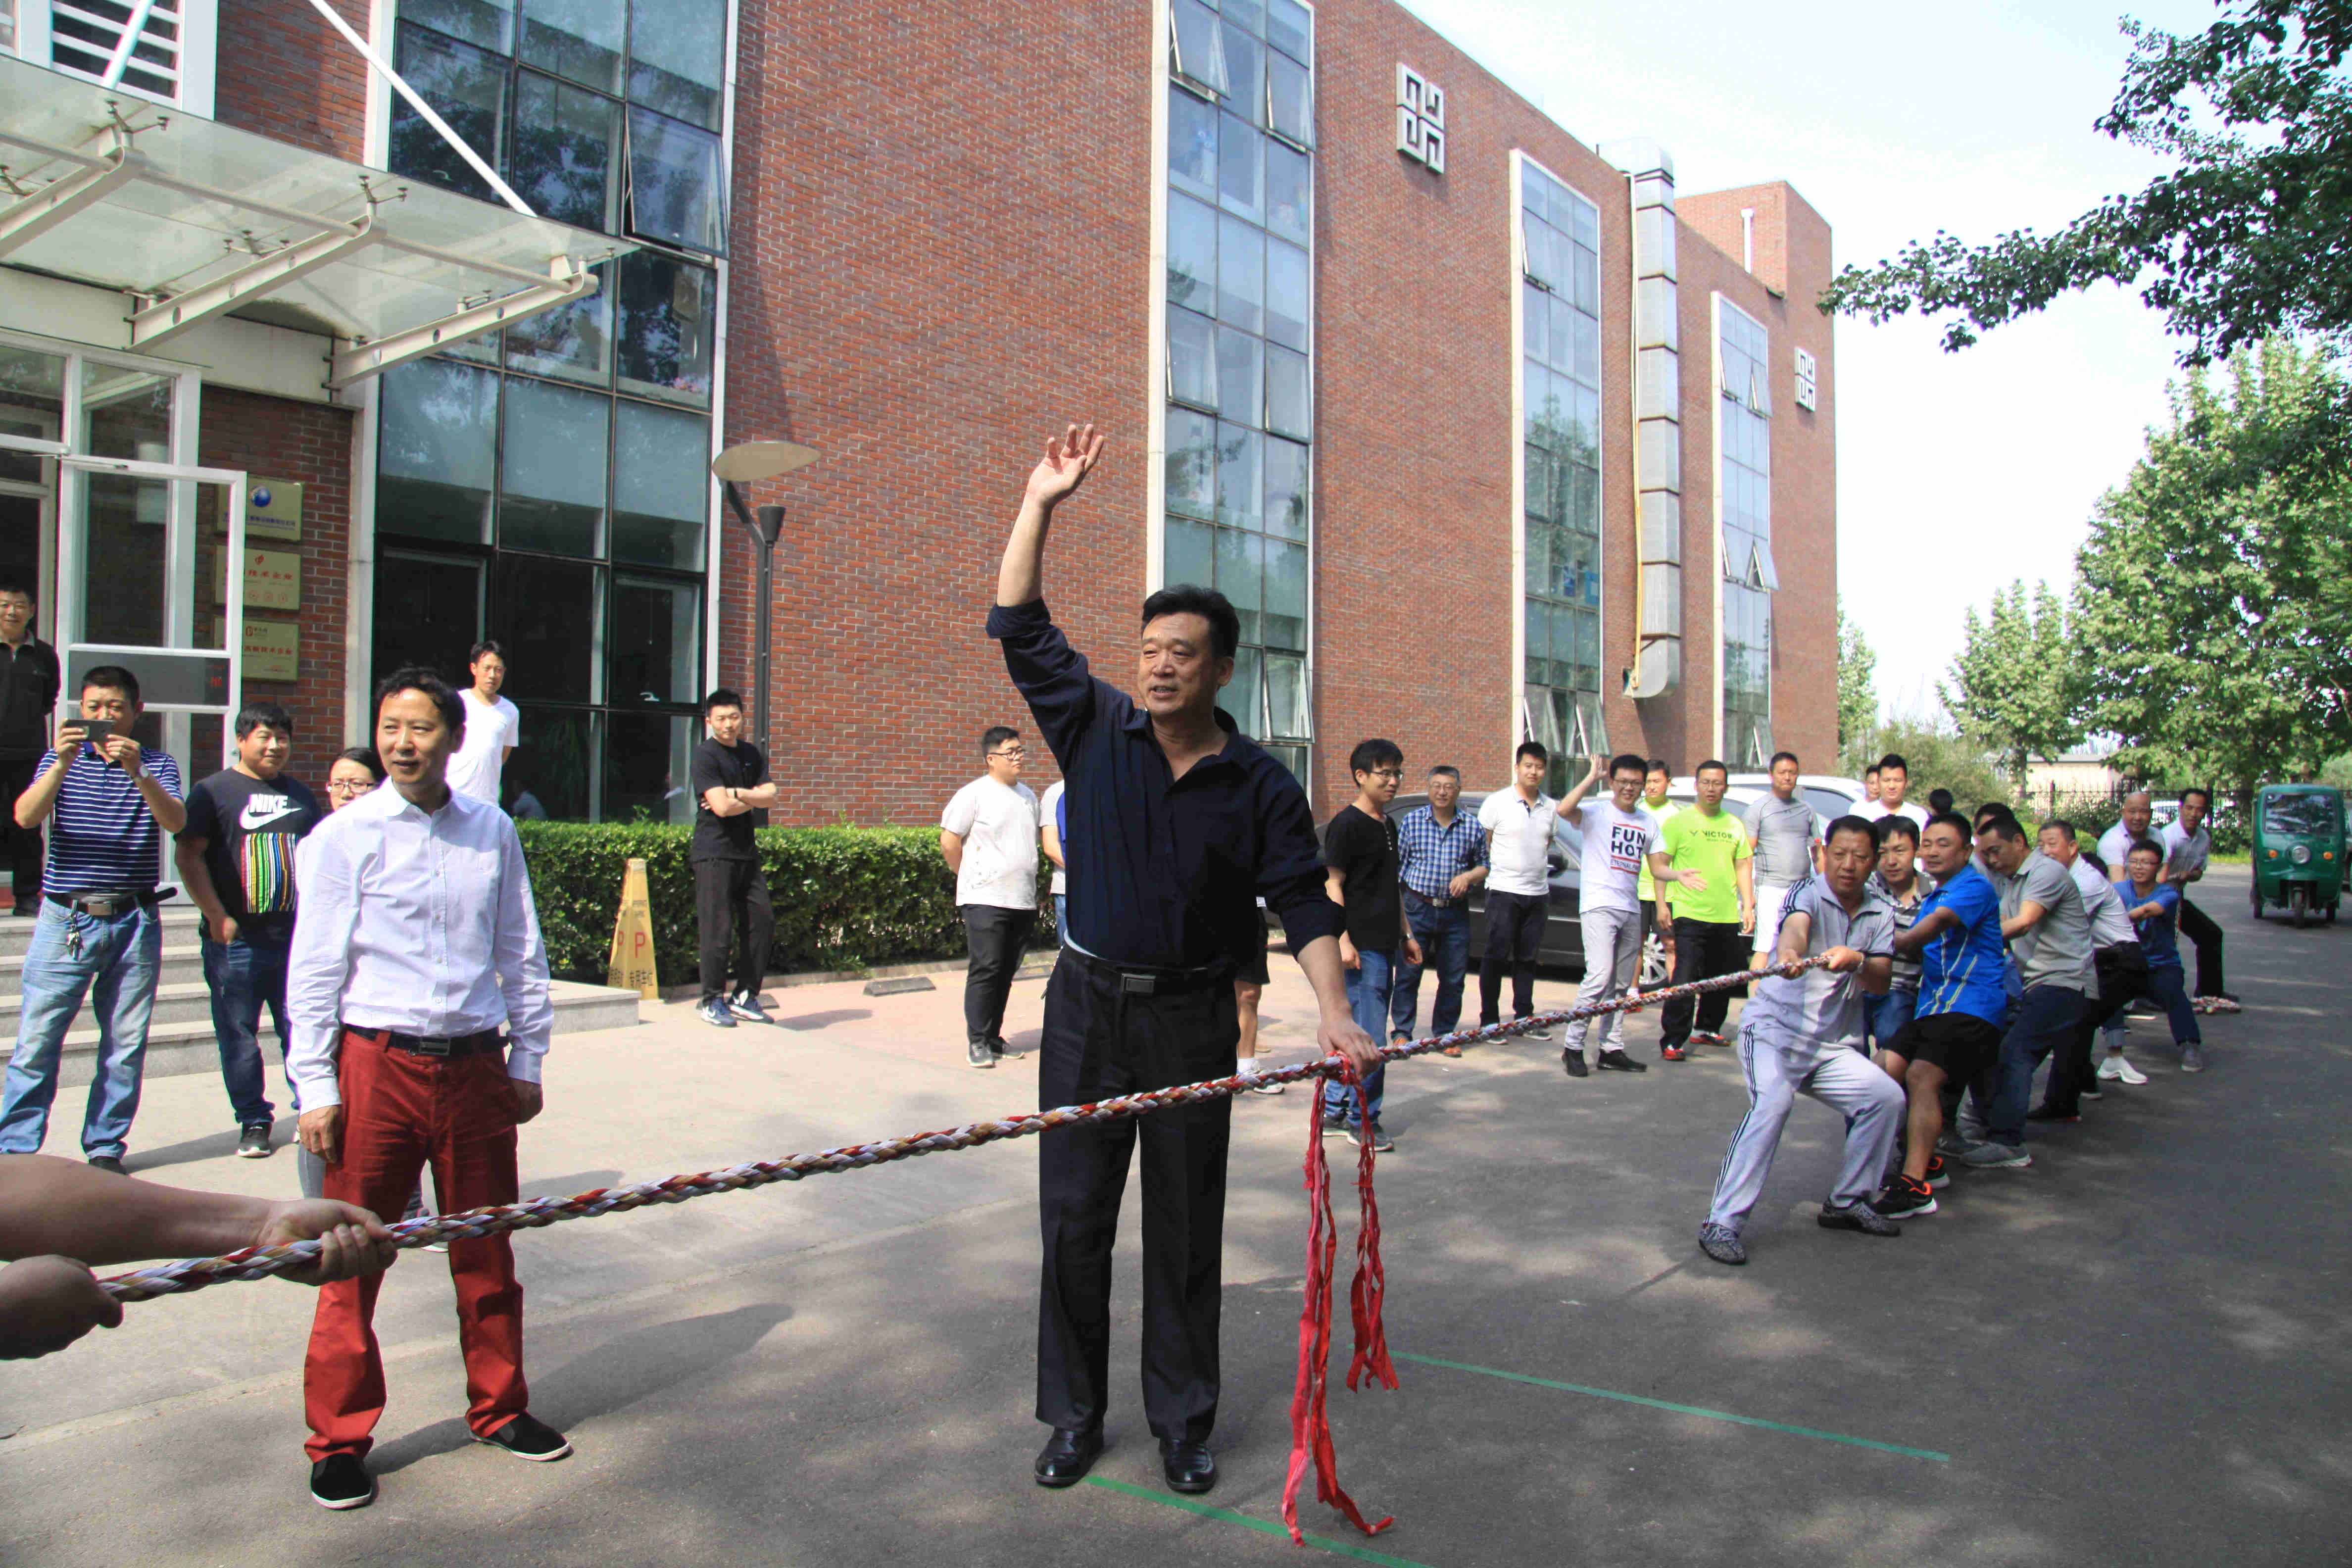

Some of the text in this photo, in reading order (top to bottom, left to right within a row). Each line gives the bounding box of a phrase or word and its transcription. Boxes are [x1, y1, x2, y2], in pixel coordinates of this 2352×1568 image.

[249, 793, 288, 813] NIKE
[1612, 826, 1646, 845] FUN
[1702, 830, 1732, 839] VICTOR
[1611, 840, 1644, 859] HOT
[635, 932, 646, 959] P
